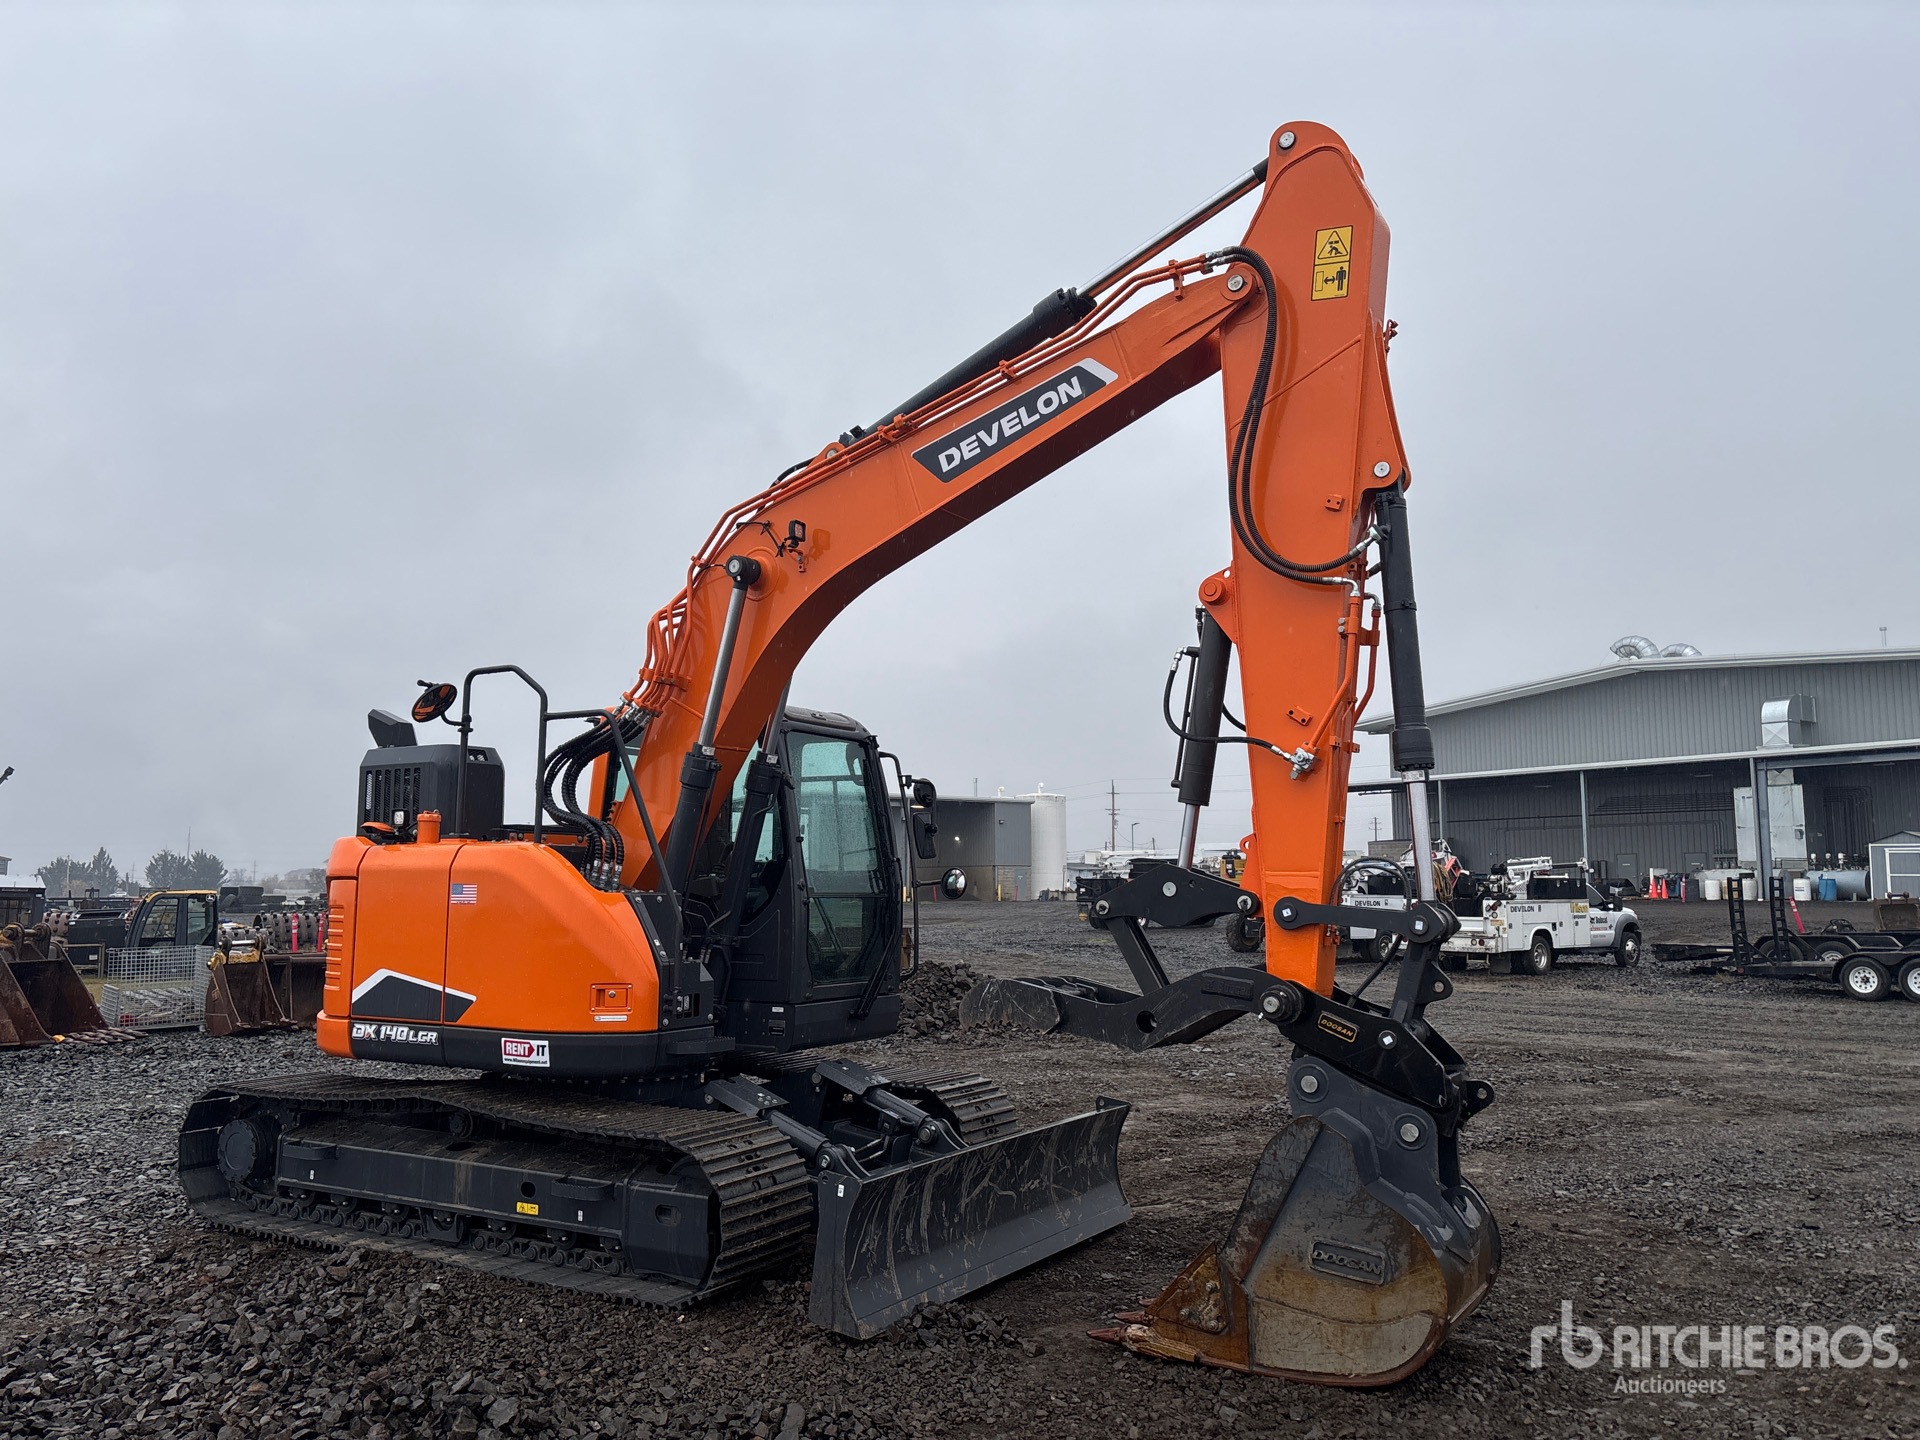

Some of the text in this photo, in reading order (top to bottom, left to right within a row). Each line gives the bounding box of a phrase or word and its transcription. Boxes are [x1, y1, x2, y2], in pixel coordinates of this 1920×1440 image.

[938, 376, 1083, 473] DEVELON
[352, 1023, 379, 1041] DX
[1321, 1019, 1353, 1036] DOOSAN
[505, 1042, 547, 1056] RENT IT
[1312, 1250, 1381, 1275] DOOSAN
